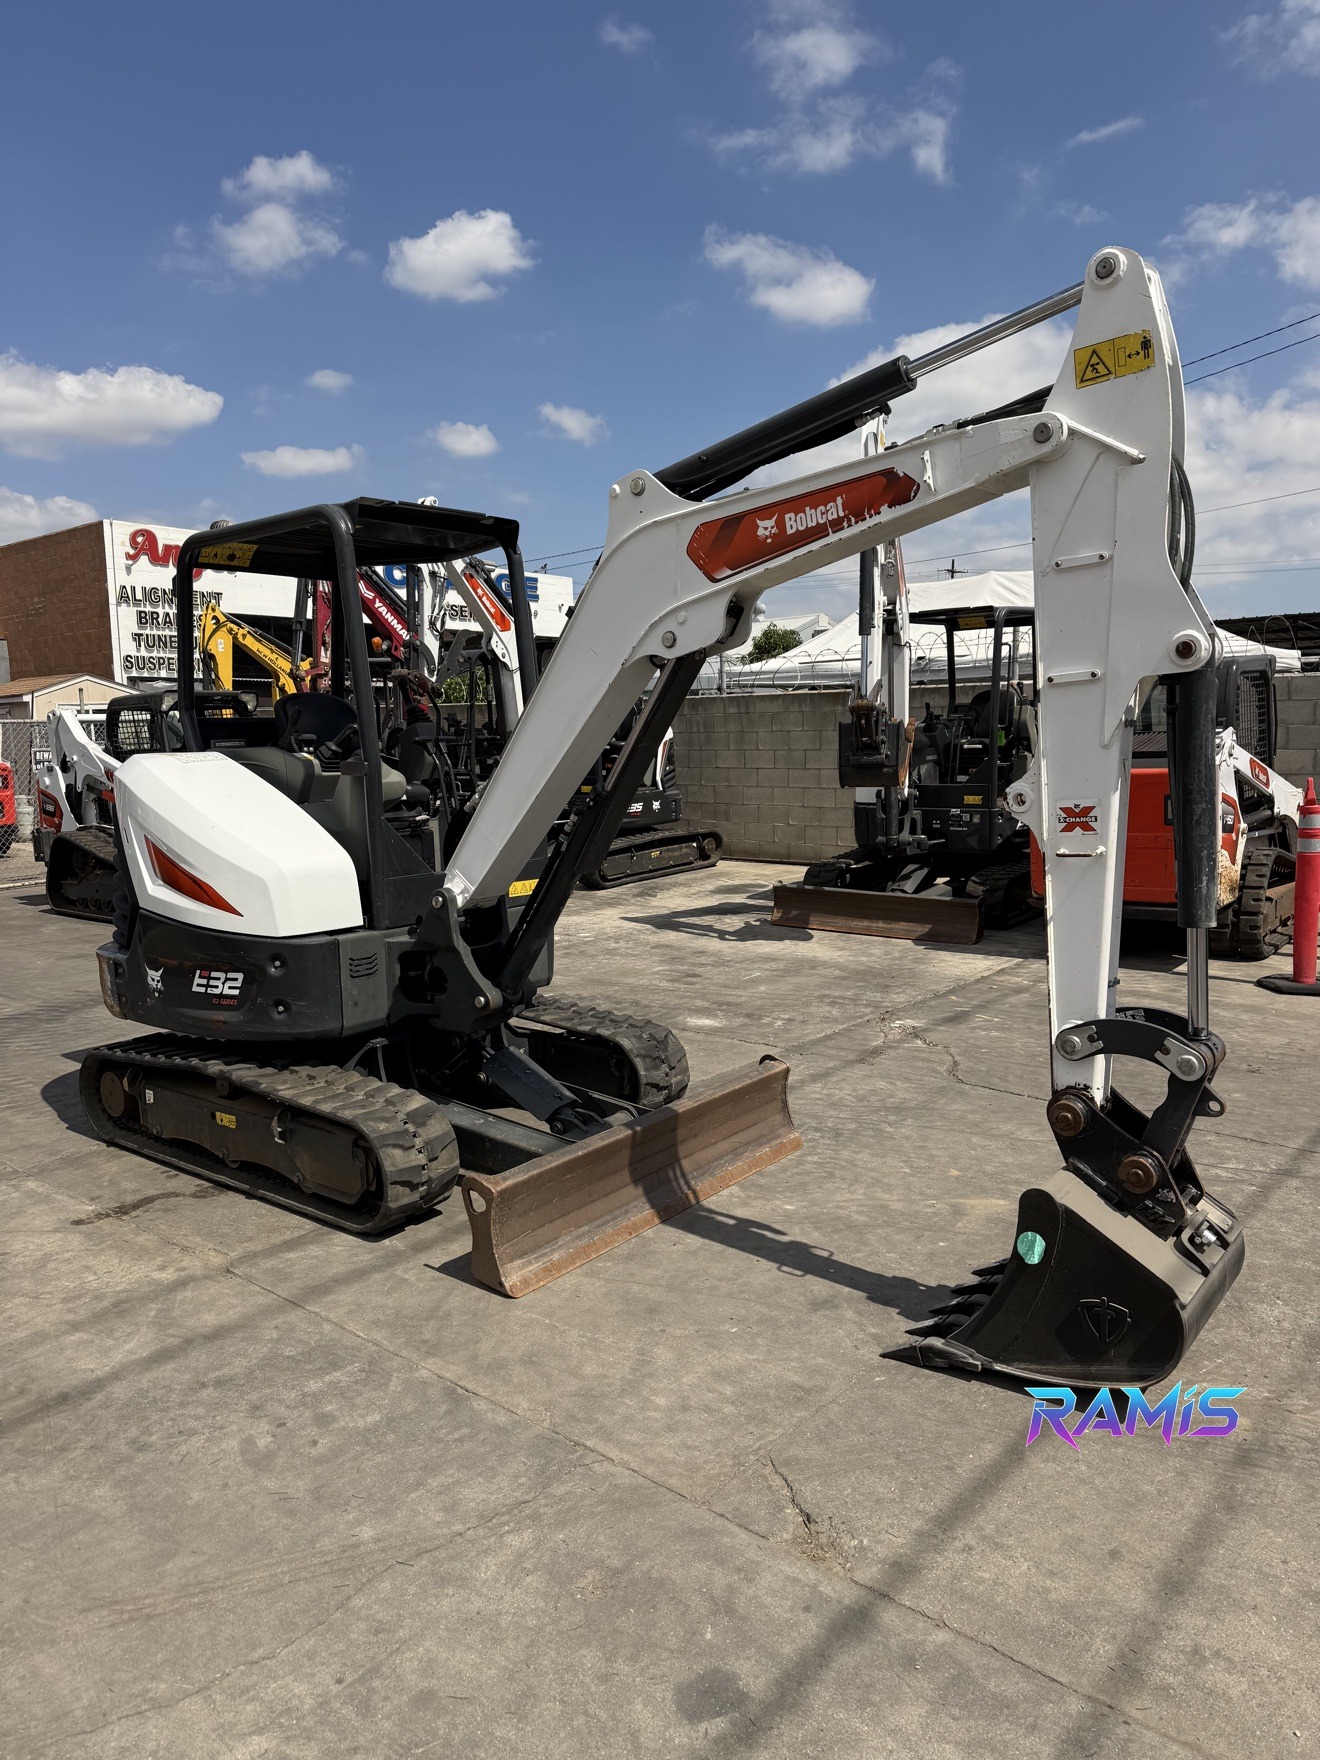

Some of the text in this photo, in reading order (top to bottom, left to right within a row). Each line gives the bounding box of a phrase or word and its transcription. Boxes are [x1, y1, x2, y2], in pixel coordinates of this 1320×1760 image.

[784, 495, 845, 536] Bobcat
[117, 584, 223, 609] ALIGNENT
[192, 970, 244, 995] E32
